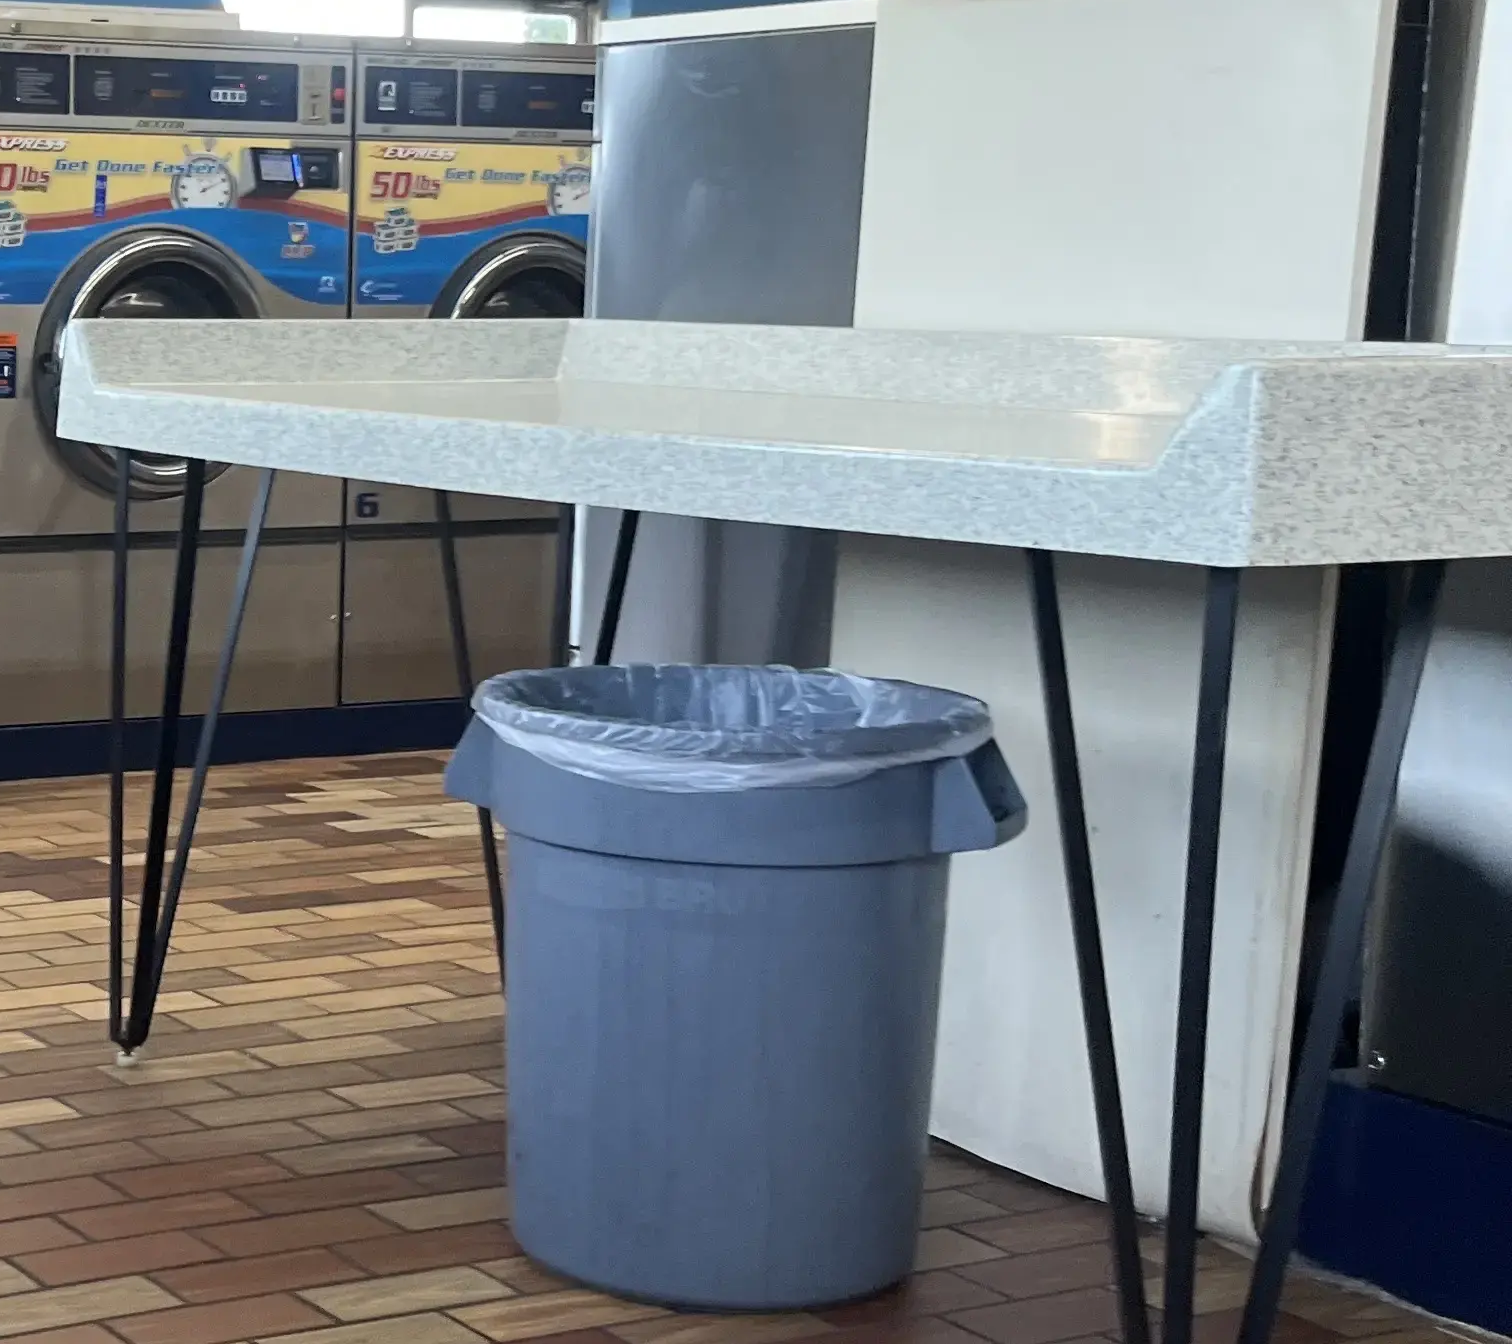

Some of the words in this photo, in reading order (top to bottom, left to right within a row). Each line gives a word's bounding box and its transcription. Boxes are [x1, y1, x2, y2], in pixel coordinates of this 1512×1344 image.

[384, 146, 456, 161] EXPRESS
[21, 166, 50, 184] lbs
[55, 159, 89, 172] Get
[97, 159, 146, 173] Done
[370, 171, 413, 199] 50
[414, 174, 441, 192] lbs
[356, 492, 380, 518] 6
